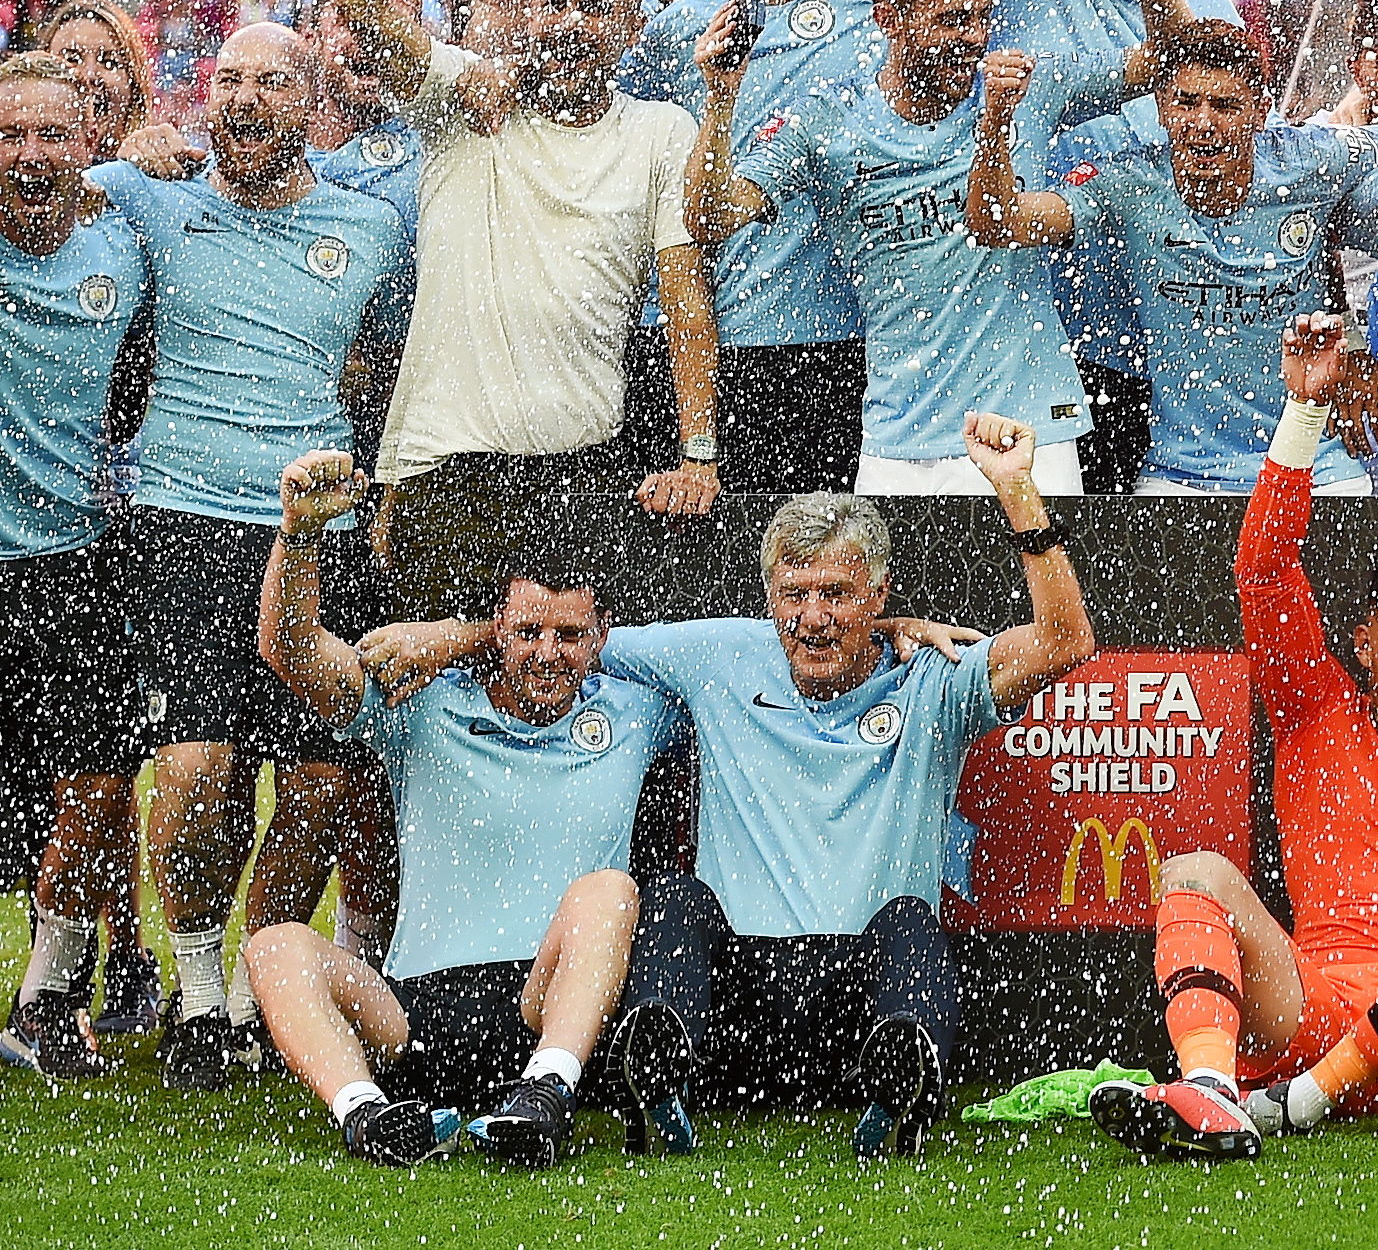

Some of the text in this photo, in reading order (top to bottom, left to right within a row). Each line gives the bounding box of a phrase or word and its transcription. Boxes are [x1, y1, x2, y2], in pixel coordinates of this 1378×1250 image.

[860, 190, 968, 230] ETIH
[893, 223, 957, 242] AIRW
[1030, 672, 1203, 722] THE FA
[1004, 726, 1224, 758] COMMUNITY
[1051, 762, 1178, 793] SHIELD
